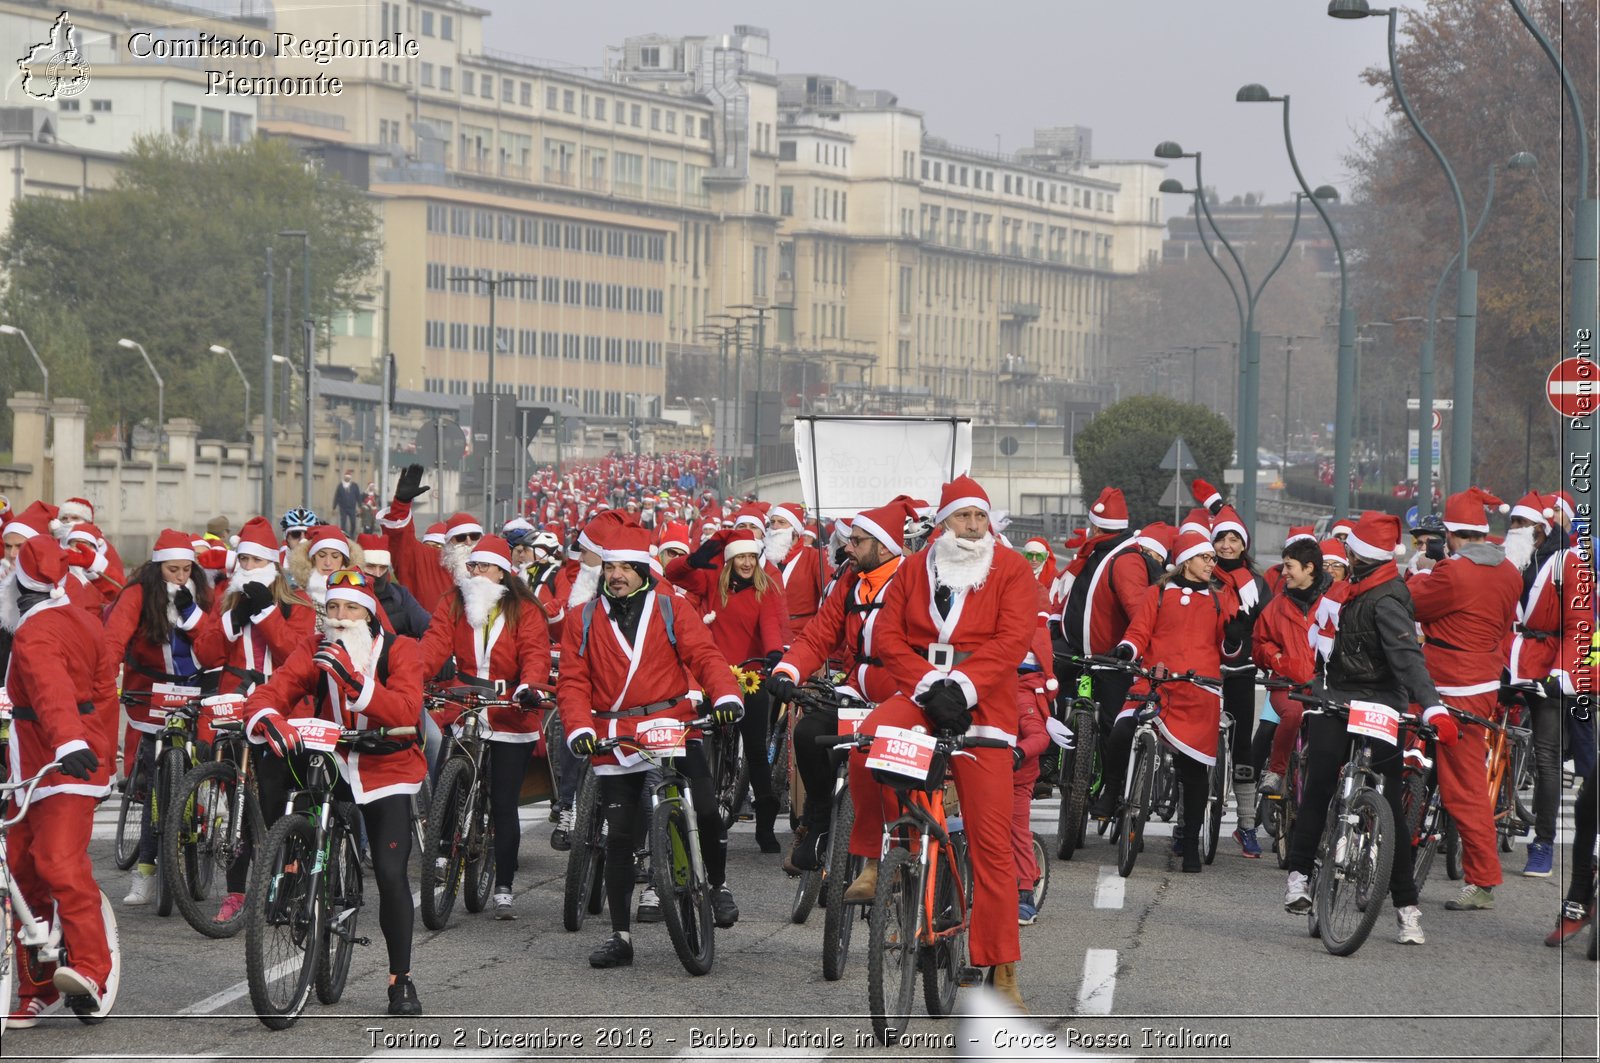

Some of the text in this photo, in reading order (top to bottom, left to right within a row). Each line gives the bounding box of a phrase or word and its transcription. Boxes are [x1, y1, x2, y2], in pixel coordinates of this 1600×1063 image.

[211, 703, 234, 716] 1003
[1364, 711, 1389, 727] 1237
[645, 729, 673, 743] 1034
[886, 739, 918, 759] 1350
